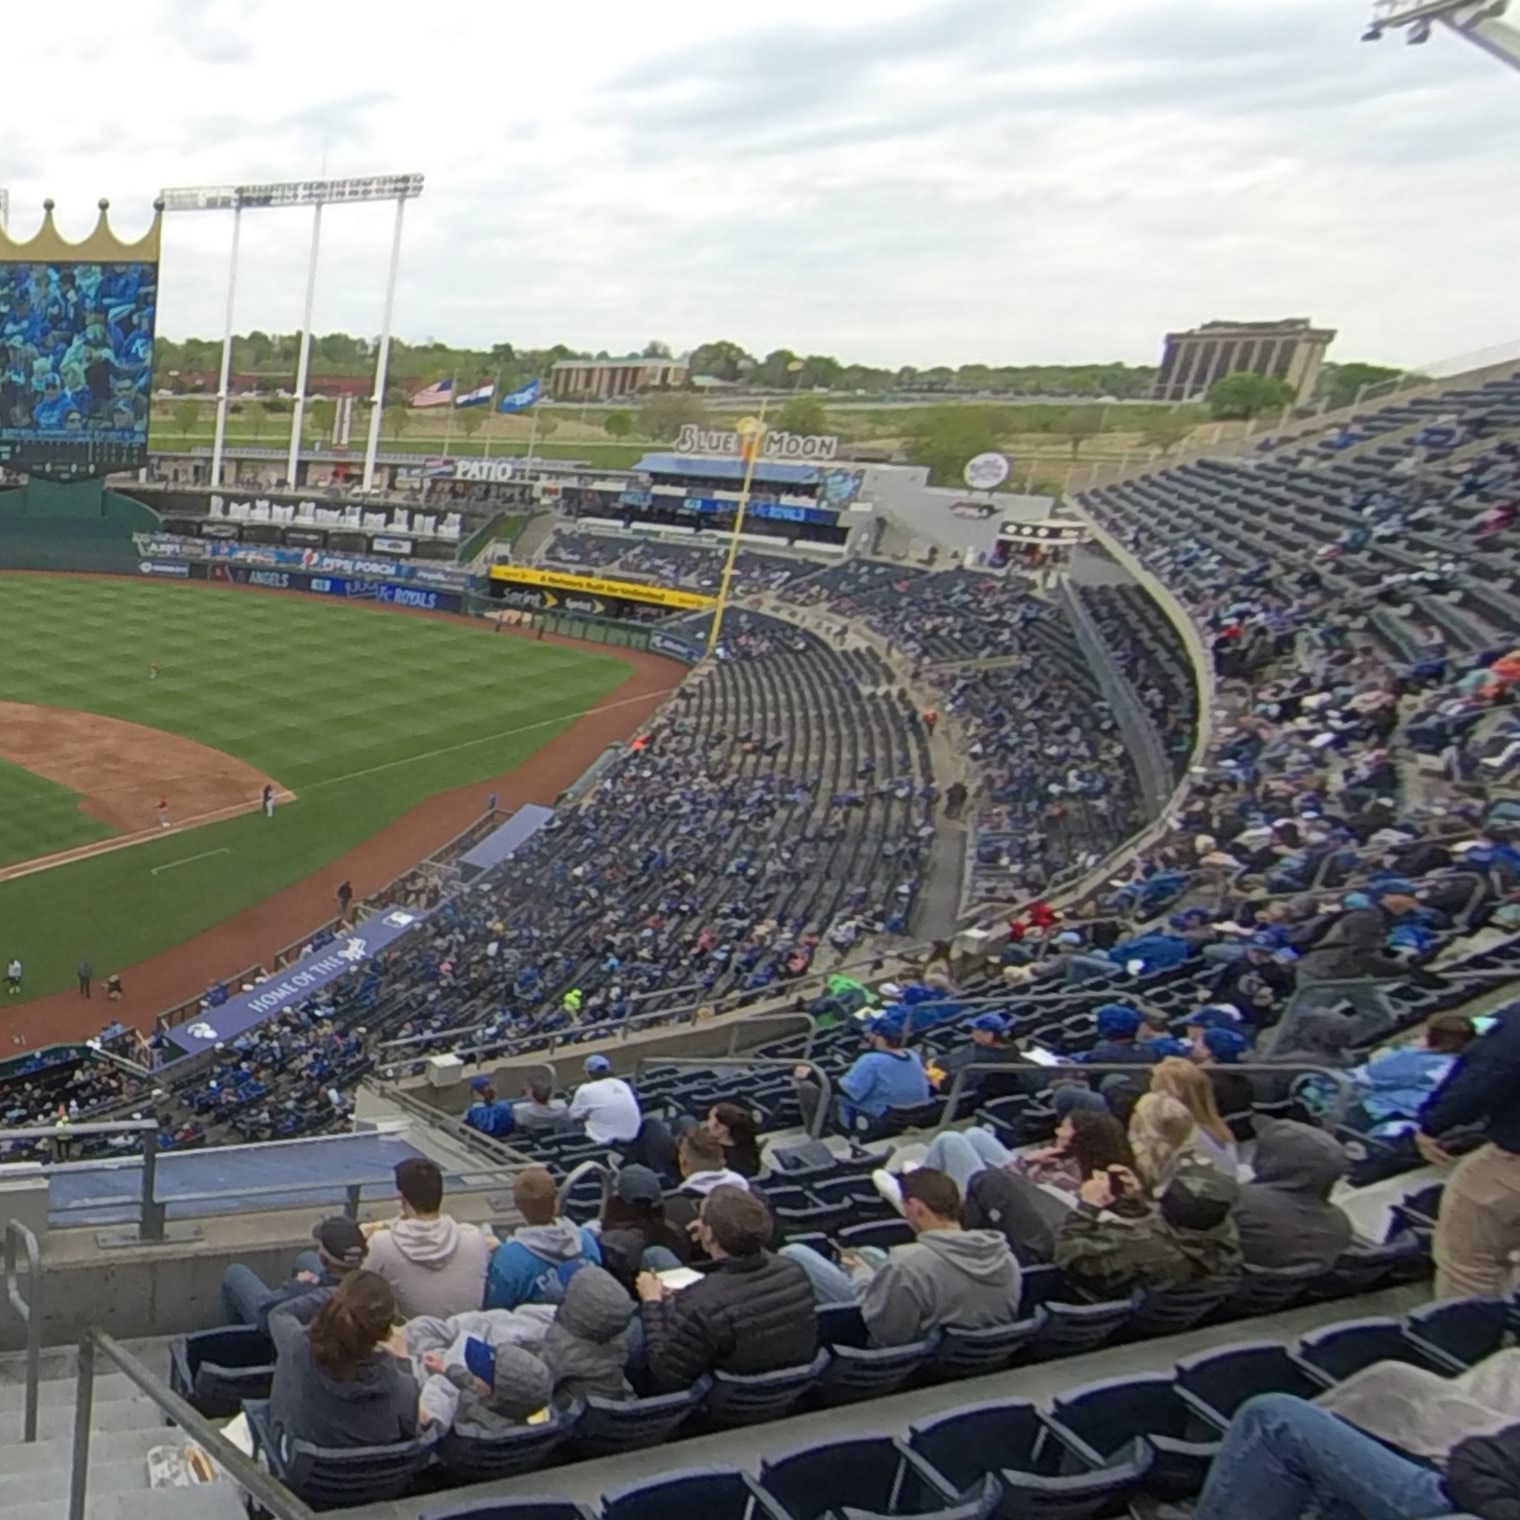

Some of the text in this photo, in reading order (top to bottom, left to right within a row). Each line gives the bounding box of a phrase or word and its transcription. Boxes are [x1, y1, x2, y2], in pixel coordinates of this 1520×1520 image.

[456, 461, 512, 481] PATIO
[248, 570, 289, 588] ANGELS
[394, 587, 437, 609] ROYALS
[247, 953, 345, 1012] HOME OF THE
